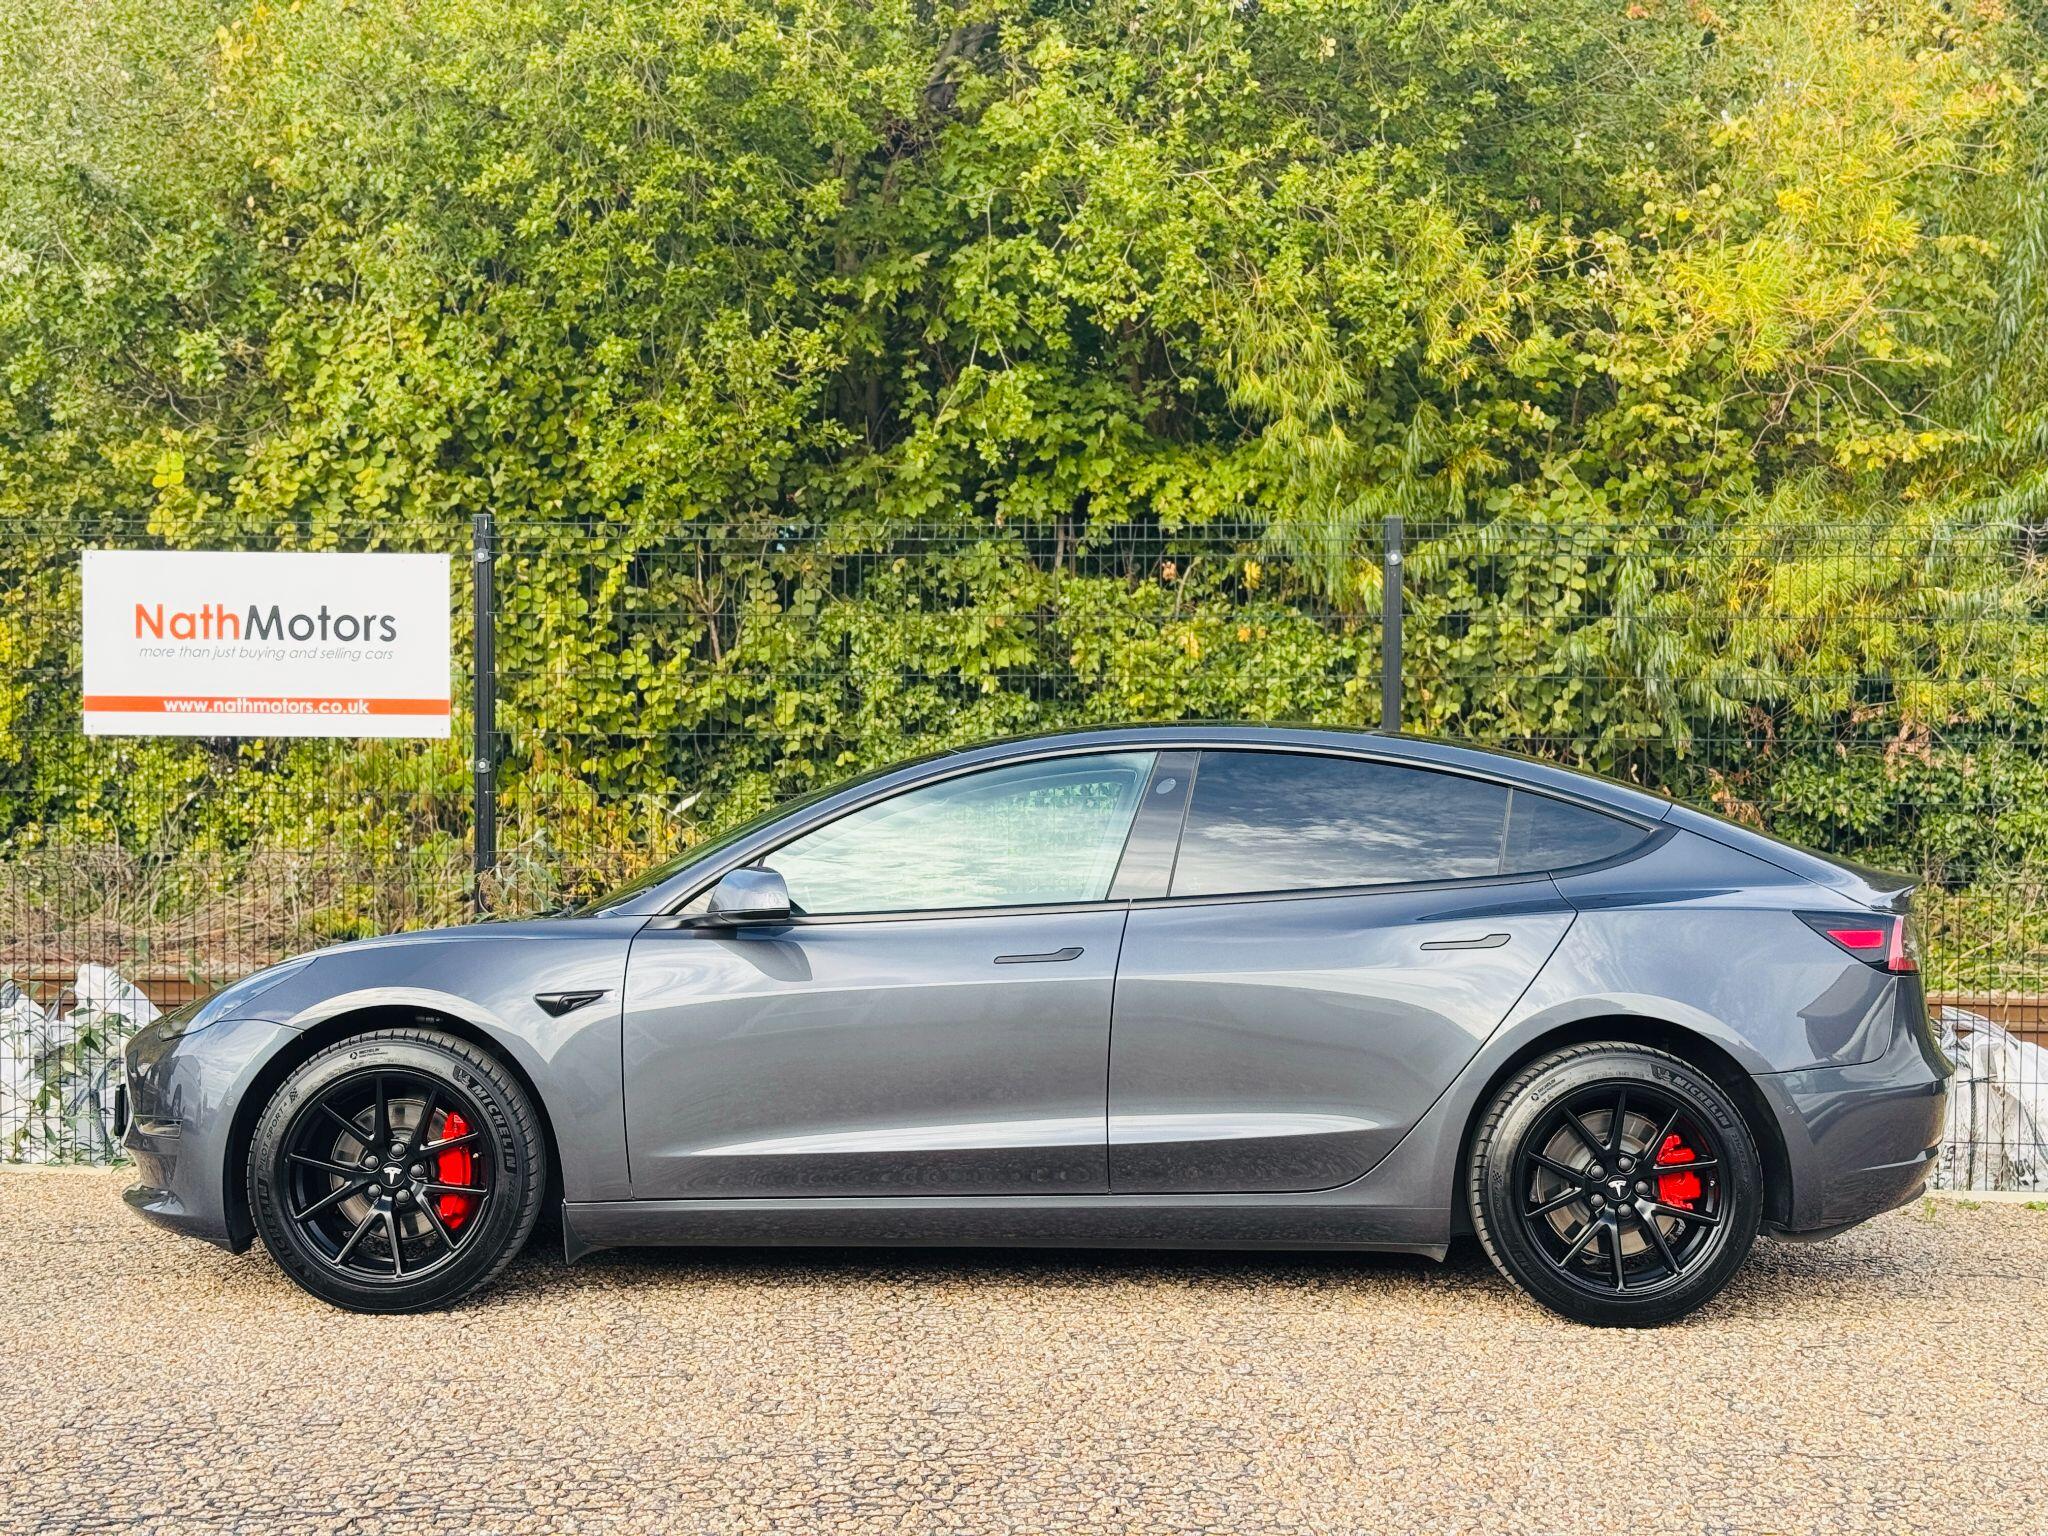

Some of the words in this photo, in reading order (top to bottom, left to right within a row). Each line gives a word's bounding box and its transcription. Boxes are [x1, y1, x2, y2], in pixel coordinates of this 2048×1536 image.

[135, 603, 397, 642] NathMotors
[139, 647, 175, 658] more
[179, 645, 211, 658] than
[212, 645, 237, 661] just
[239, 645, 286, 661] buying
[289, 647, 318, 659] and
[320, 647, 362, 662] selling
[365, 650, 395, 660] cars
[163, 697, 370, 715] www.nathmotors.co.uk
[1671, 1075, 1732, 1127] MICHELIN
[258, 1142, 269, 1172] PILOT
[266, 1106, 284, 1140] SPORT
[471, 1084, 516, 1168] MICHELIN
